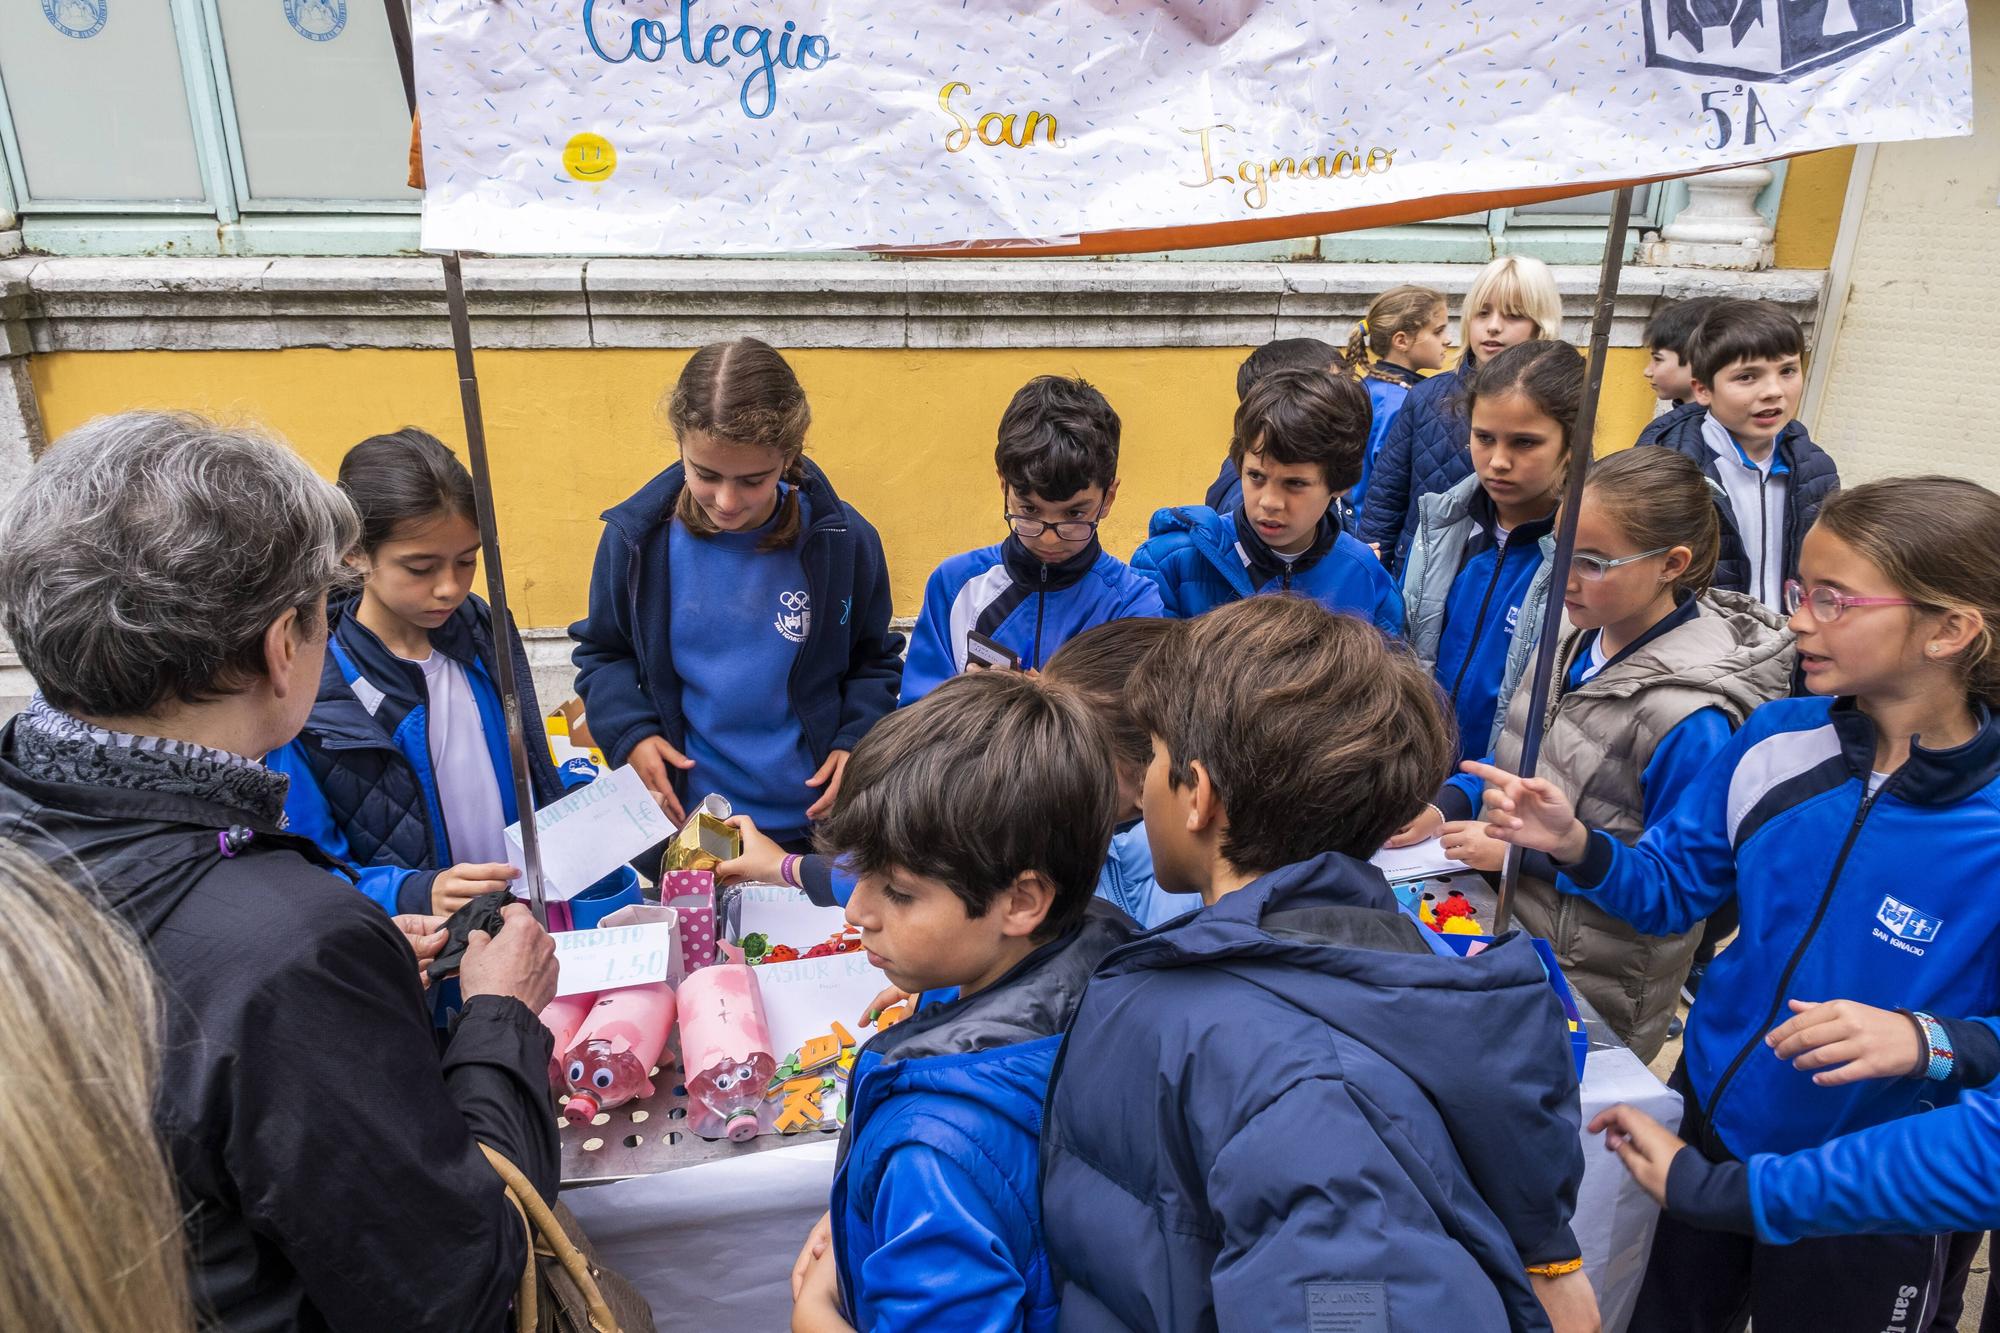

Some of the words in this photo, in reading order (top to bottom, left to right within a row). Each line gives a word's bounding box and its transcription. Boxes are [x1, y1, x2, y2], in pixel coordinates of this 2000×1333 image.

[583, 0, 840, 119] Colegio
[938, 81, 1066, 153] San
[1179, 124, 1397, 209] Ignacio
[1872, 927, 1889, 942] SAN
[1889, 936, 1925, 957] IGNACIO
[766, 960, 828, 984] ASTUR
[1891, 1285, 1918, 1322] San
